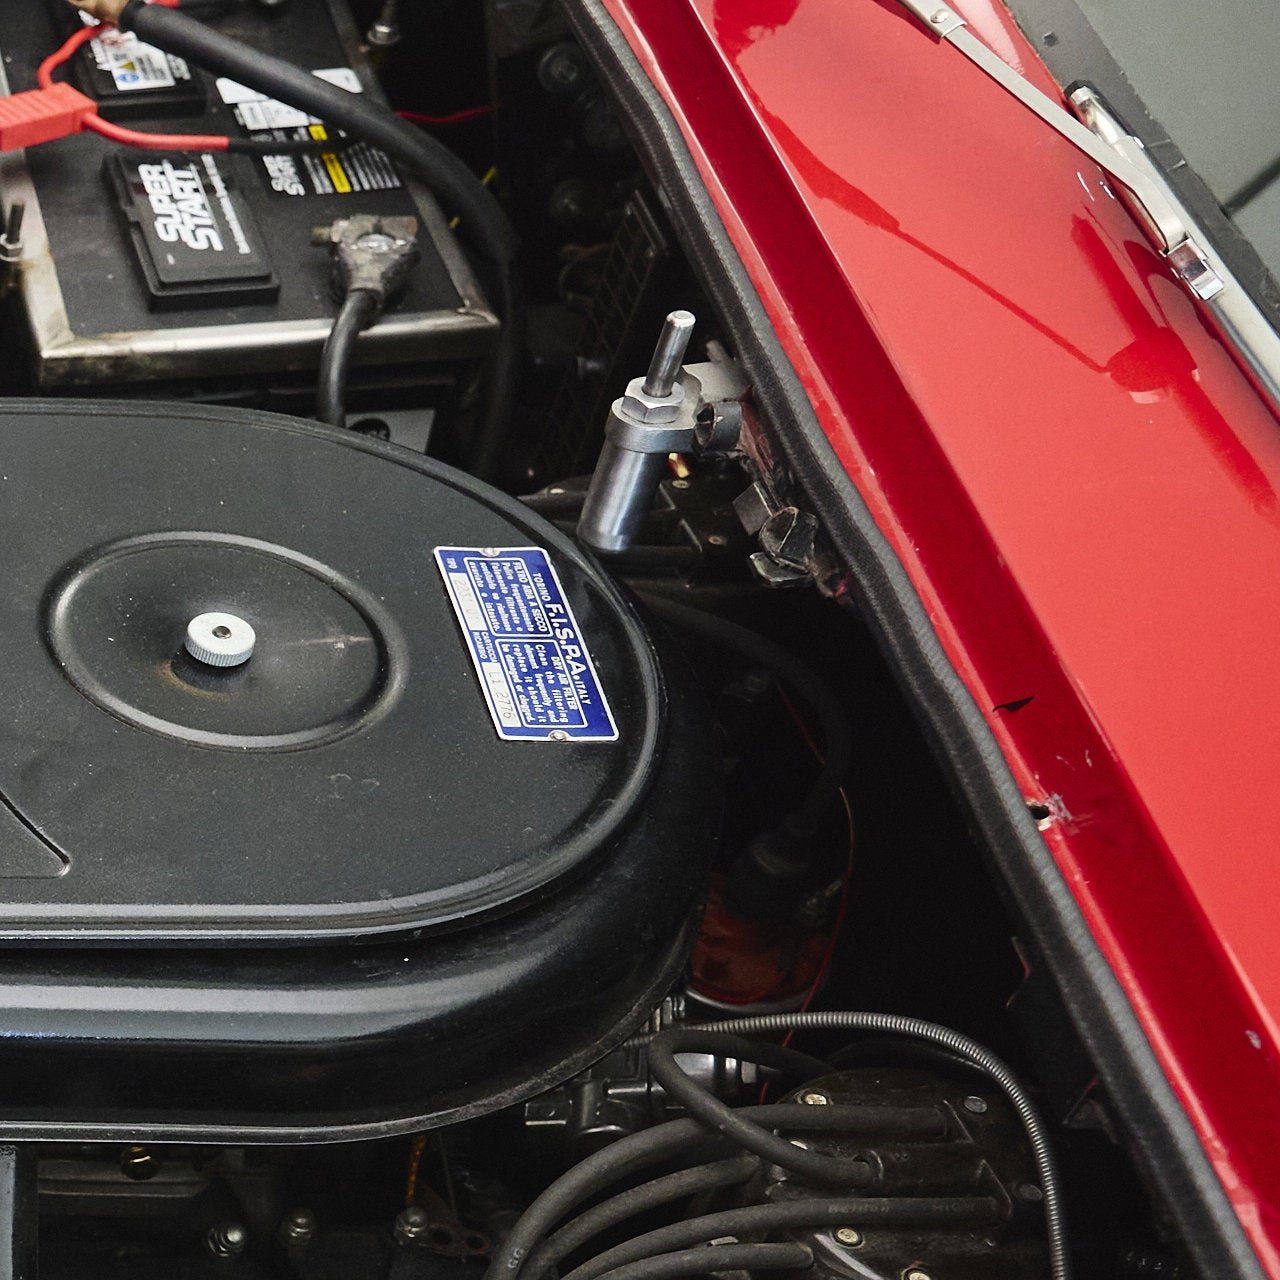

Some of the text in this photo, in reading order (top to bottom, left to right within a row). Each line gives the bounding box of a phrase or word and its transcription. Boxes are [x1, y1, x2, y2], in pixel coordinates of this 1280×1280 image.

[138, 164, 181, 242] SUPER
[162, 159, 223, 250] START
[468, 561, 485, 587] avariato
[508, 584, 535, 631] frequentemente
[511, 561, 528, 582] FILTRO
[521, 584, 535, 599] ARIA
[530, 608, 547, 631] SECCO
[504, 597, 522, 623] filtrante
[531, 572, 551, 600] TORINO
[573, 681, 591, 704] ITALY
[480, 631, 498, 662] CARTUCCIA
[510, 644, 530, 672] replace
[526, 686, 544, 712] should
[502, 654, 522, 682] damaged
[518, 694, 535, 722] clogged.
[523, 644, 559, 722] element frequently and
[534, 644, 572, 722] Clean the filtering
[549, 656, 578, 709] DRY AIR FILTER
